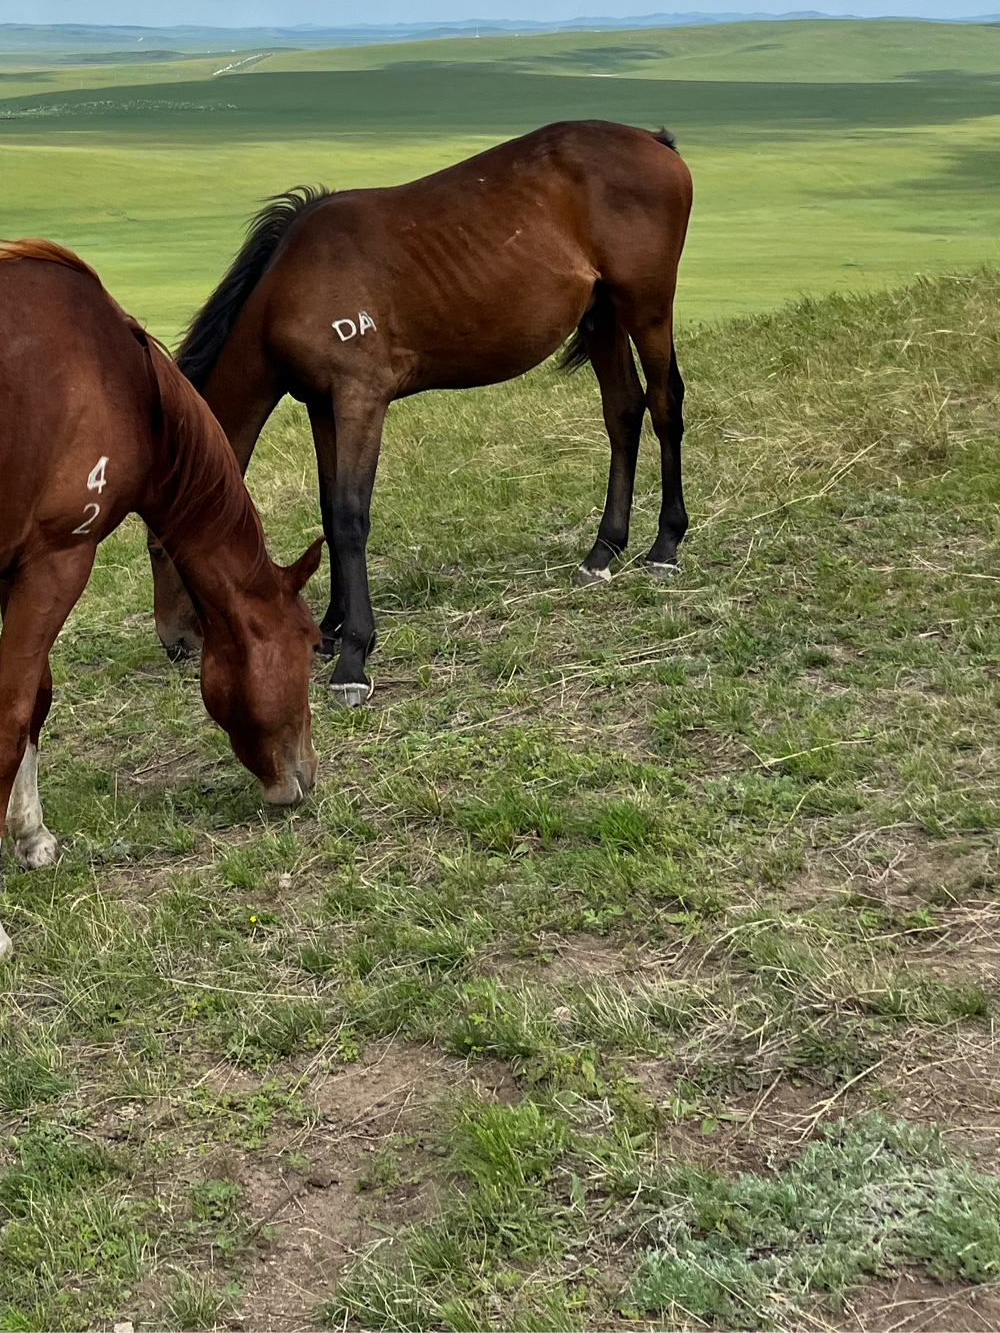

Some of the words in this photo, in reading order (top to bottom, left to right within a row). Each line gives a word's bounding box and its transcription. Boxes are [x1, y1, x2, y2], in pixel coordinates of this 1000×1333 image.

[332, 311, 377, 342] DA
[87, 456, 109, 494] 4
[71, 503, 100, 534] 2
